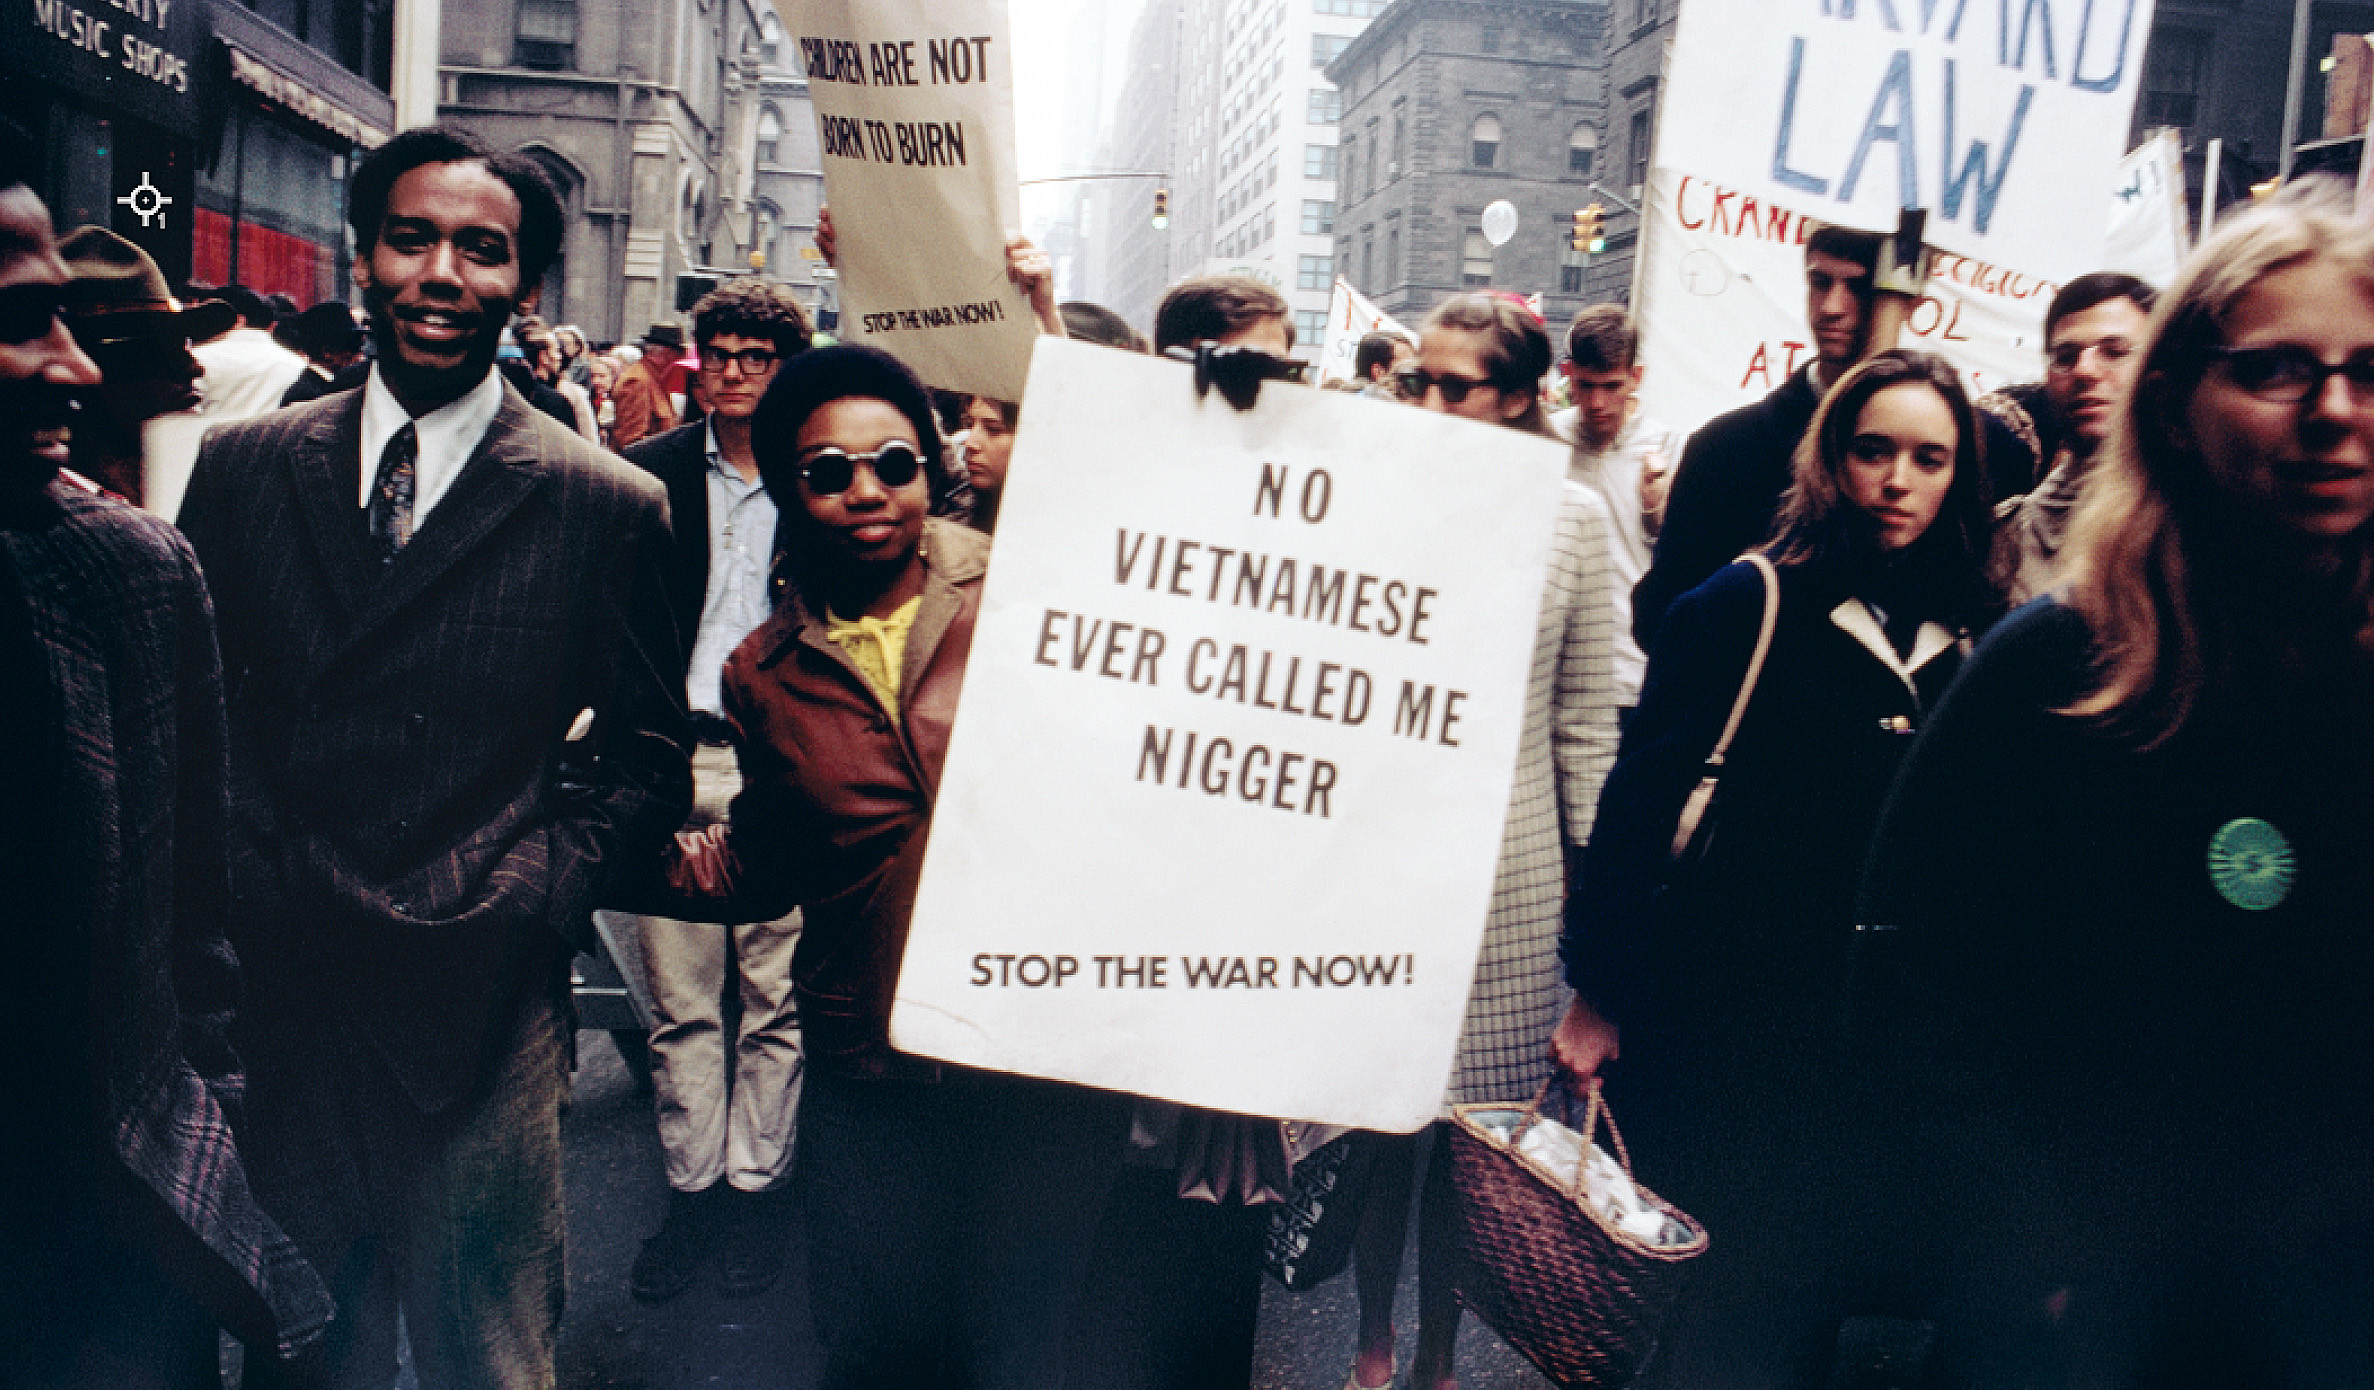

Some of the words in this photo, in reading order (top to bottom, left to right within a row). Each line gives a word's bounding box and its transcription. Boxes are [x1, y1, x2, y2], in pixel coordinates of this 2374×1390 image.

[33, 0, 111, 58] MUSIC
[121, 33, 189, 94] SHOPS
[869, 41, 919, 87] ARE
[927, 36, 992, 85] NOT
[821, 113, 867, 162] BORN
[863, 119, 894, 165] TO
[894, 120, 967, 168] BURN
[1770, 35, 2036, 237] LAW
[864, 311, 897, 335] STOP
[897, 309, 921, 331] THE
[918, 305, 956, 328] WAR
[953, 298, 1006, 326] NOW!
[1253, 461, 1333, 525] NO
[1114, 528, 1438, 645] VIETNAMESE
[1034, 609, 1167, 687] EVER
[1185, 636, 1373, 728] CALLED
[1392, 679, 1469, 748] ME
[1136, 724, 1338, 820] NIGGER
[970, 953, 1079, 988] STOP
[1093, 955, 1167, 989] THE
[1182, 955, 1279, 989] WAR
[1292, 953, 1415, 989] NOW!
